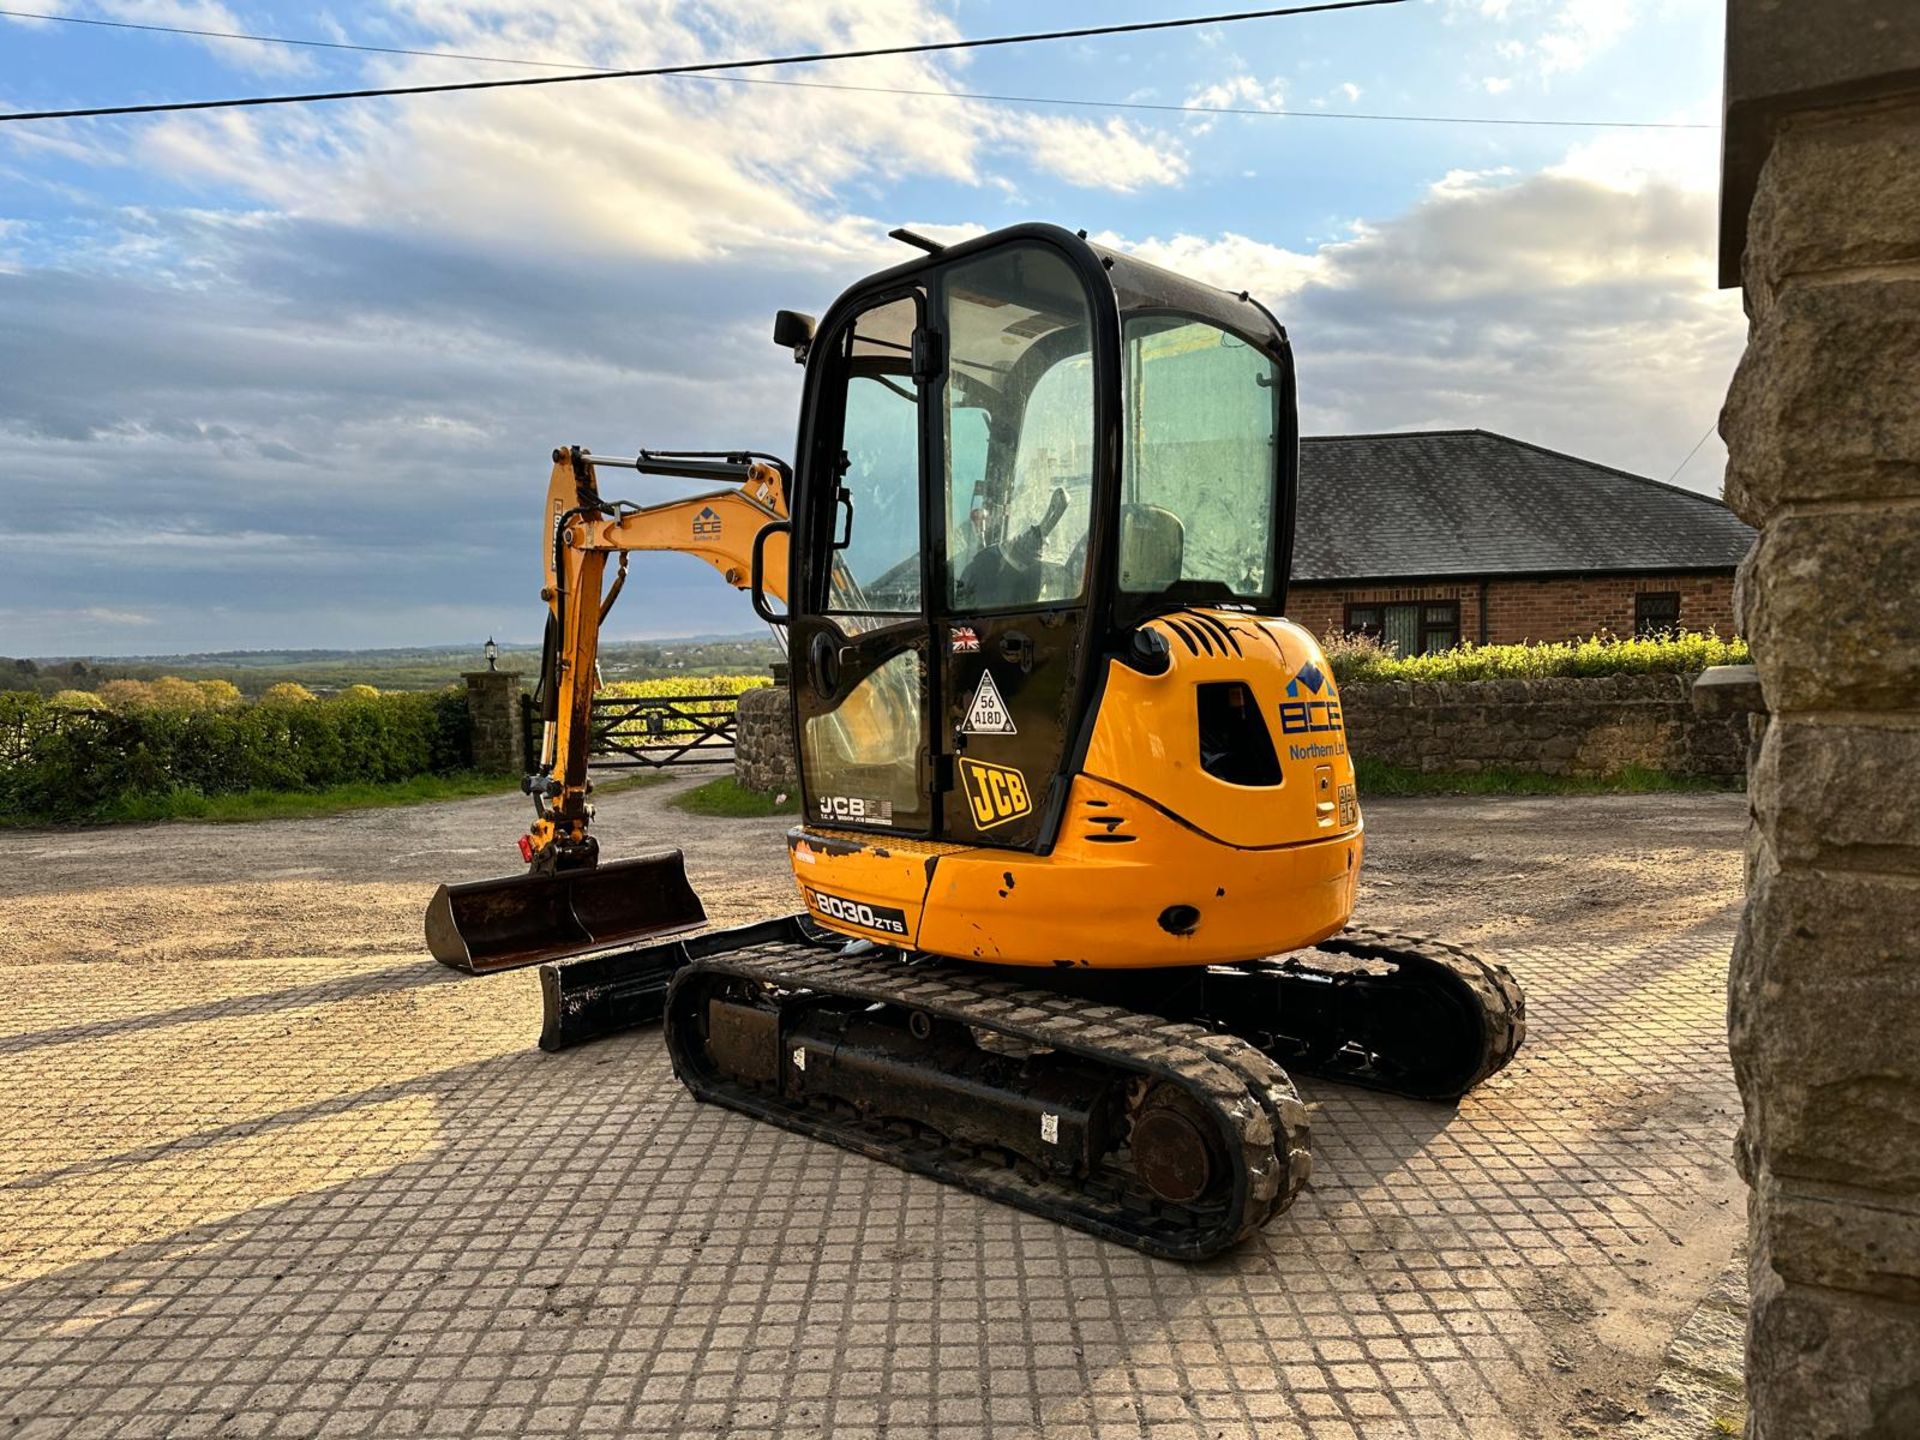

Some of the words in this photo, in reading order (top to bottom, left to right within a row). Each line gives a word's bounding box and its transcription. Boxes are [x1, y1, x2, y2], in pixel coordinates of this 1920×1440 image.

[693, 521, 721, 534] BCE
[981, 696, 995, 709] 56
[1279, 702, 1342, 734] BCE
[1289, 743, 1334, 761] Northern
[971, 766, 1027, 822] JCB
[820, 796, 865, 816] JCB
